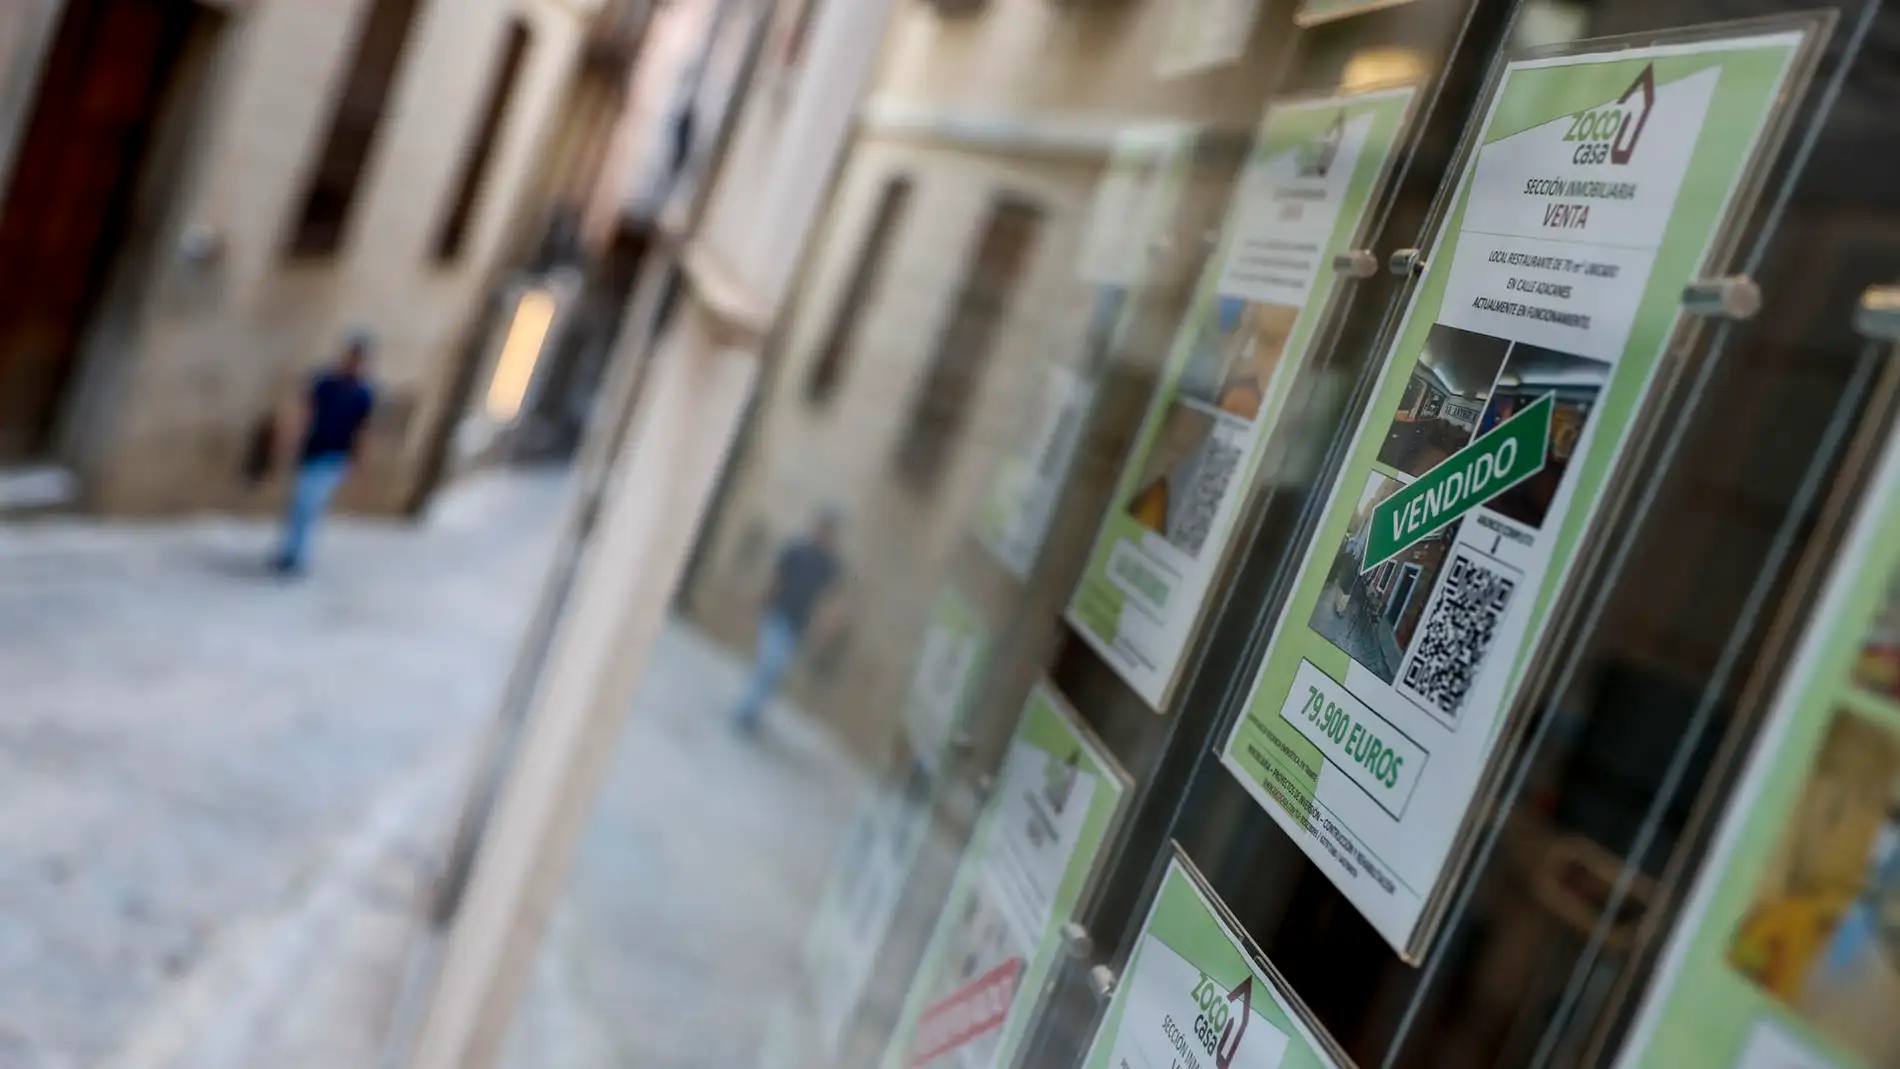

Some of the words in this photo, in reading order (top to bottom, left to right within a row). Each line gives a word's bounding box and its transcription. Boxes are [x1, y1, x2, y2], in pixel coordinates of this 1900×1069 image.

[1572, 143, 1609, 165] casa
[1524, 176, 1565, 197] SECCIÓN
[1564, 180, 1636, 200] INMOBILIARIA
[1543, 203, 1590, 229] VENTA
[1488, 250, 1508, 264] LOCAL
[1508, 253, 1553, 270] RESTAURANTE
[1506, 277, 1518, 290] EN
[1472, 296, 1518, 315] ACTUALMENTE
[1393, 437, 1517, 542] VENDIDO
[1301, 685, 1350, 745] 79.900
[1344, 722, 1404, 789] EUROS
[1162, 1014, 1189, 1058] SECCIÓN
[1194, 1014, 1218, 1057] casa
